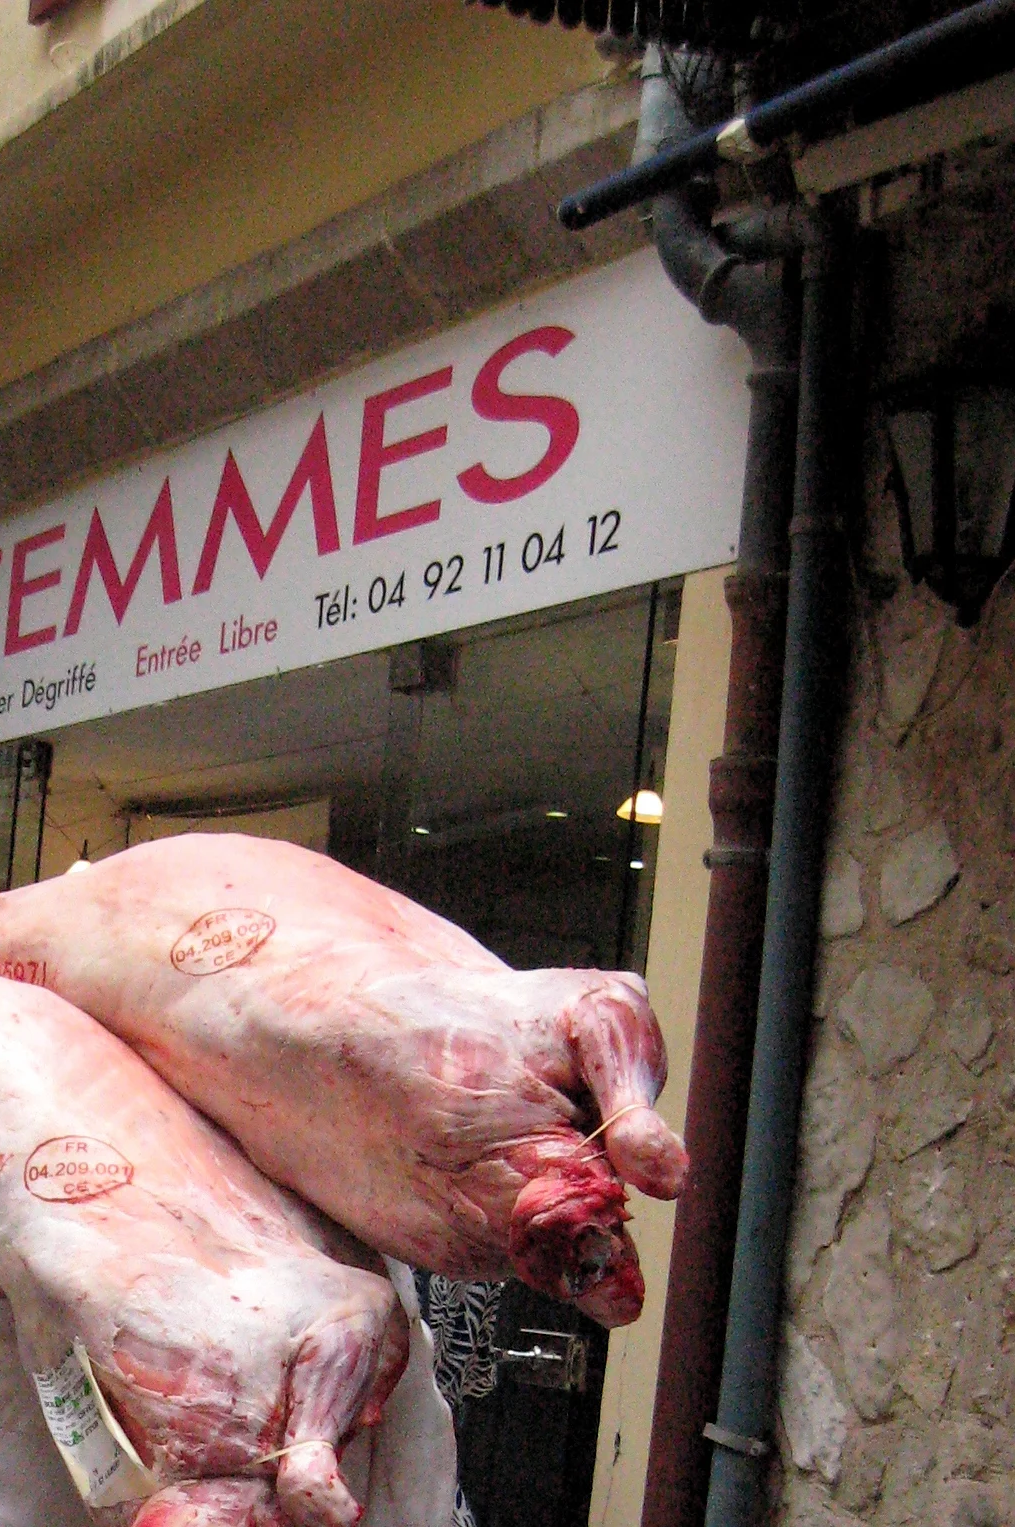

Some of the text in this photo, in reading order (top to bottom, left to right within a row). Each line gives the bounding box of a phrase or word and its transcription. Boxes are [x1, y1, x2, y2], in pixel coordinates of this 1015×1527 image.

[315, 509, 622, 630] Tél: 04 92 11 04 12
[135, 614, 279, 678] Entrée Libre
[22, 662, 97, 711] Dégriffé
[205, 913, 227, 929] FR
[213, 949, 235, 966] CE
[65, 1141, 88, 1153] FR
[28, 1162, 130, 1181] 04.209.001
[63, 1182, 90, 1195] CE
